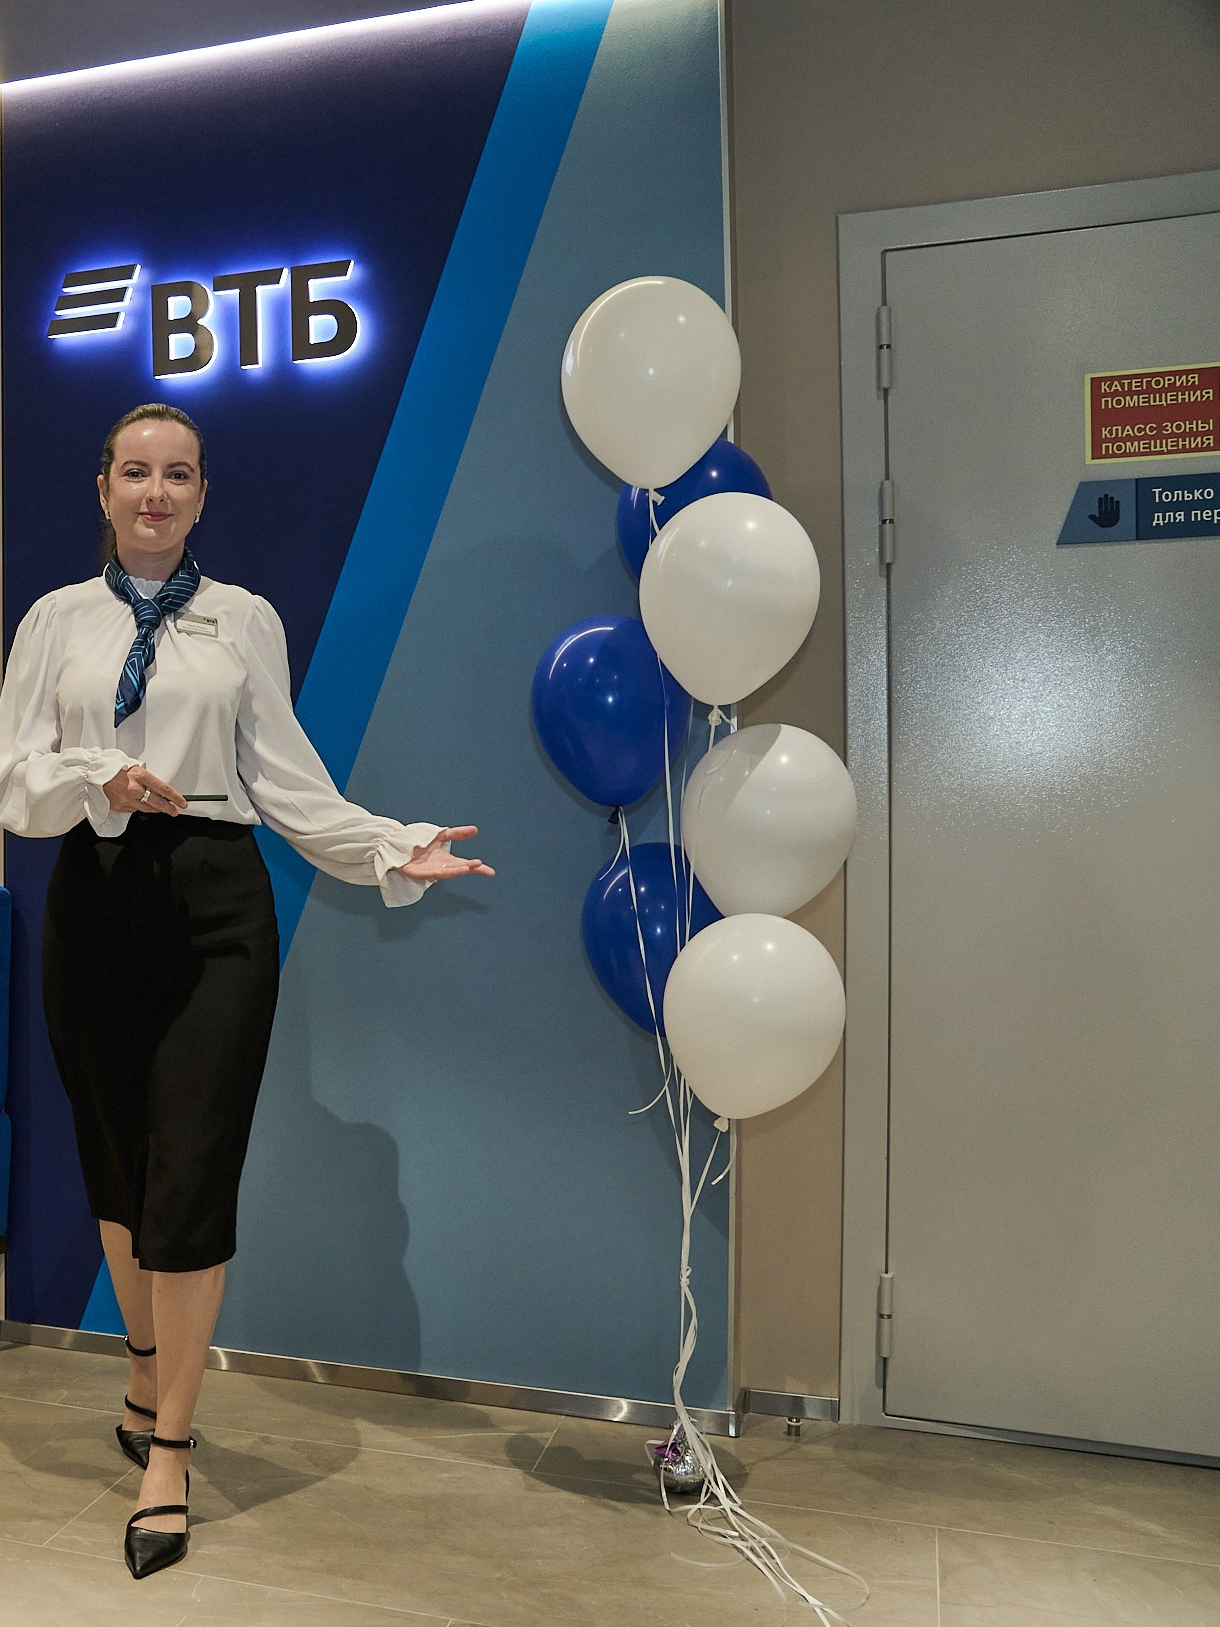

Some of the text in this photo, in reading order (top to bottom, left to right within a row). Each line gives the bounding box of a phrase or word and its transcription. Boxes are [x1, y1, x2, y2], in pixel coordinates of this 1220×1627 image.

[150, 260, 359, 380] ВТБ
[1101, 373, 1199, 393] КАТЕГОРИЯ
[1101, 389, 1213, 409] ПОМЕЩЕНИЯ
[1101, 419, 1214, 439] КЛАСС ЗОНЫ
[1101, 435, 1214, 455] ПОМЕЩЕНИЯ
[1152, 488, 1214, 503] Только
[1152, 511, 1185, 526] для
